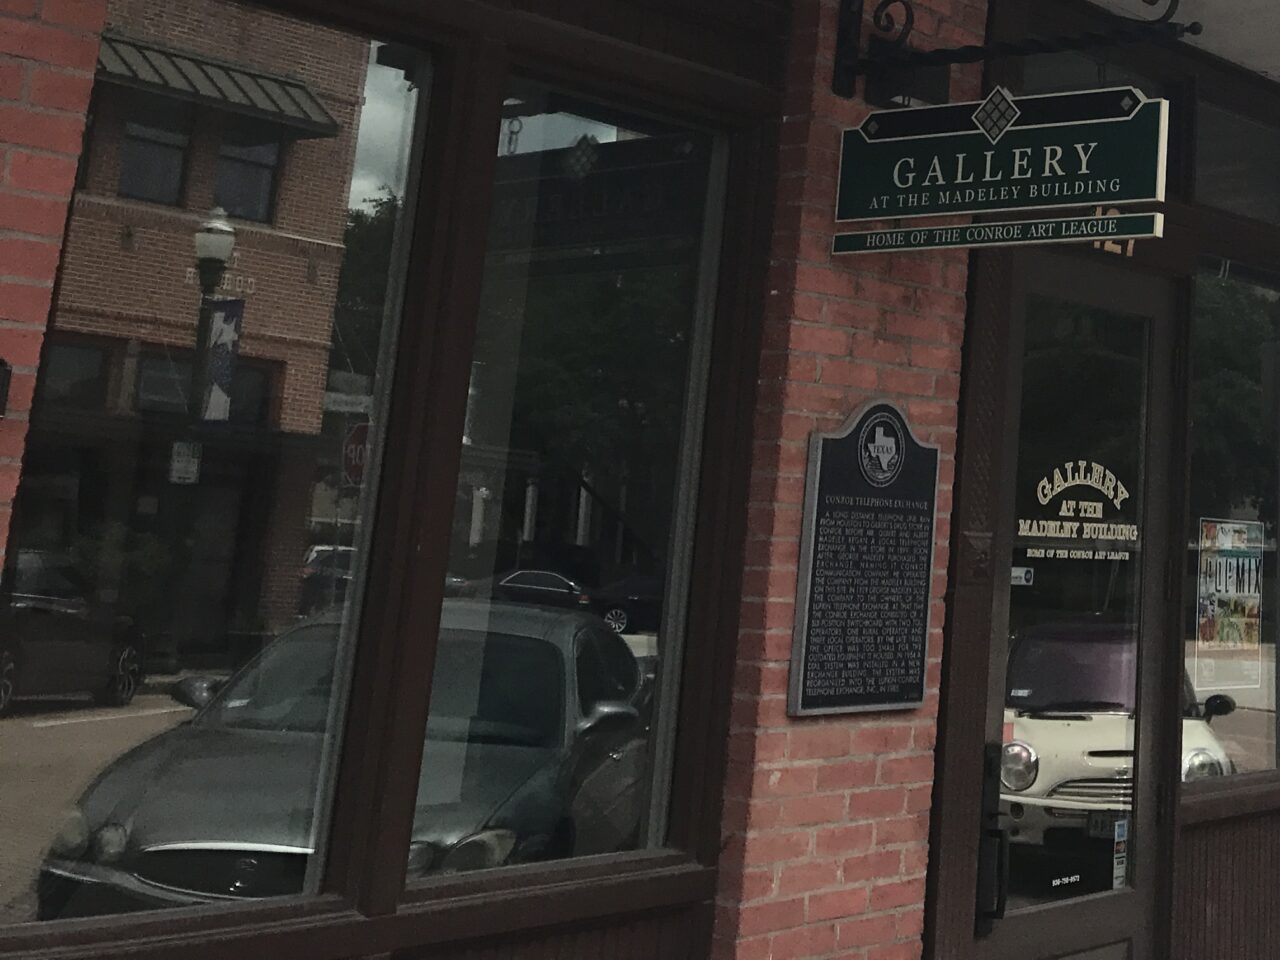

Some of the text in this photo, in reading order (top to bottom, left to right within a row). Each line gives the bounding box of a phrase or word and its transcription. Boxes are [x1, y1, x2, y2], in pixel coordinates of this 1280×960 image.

[893, 142, 1098, 188] GALLERY
[868, 178, 1121, 210] AT THE MADELEY BUILDING
[866, 219, 1118, 247] HOME OF THE CONROE ART LEAGUE
[872, 444, 893, 454] TEXAS
[1037, 460, 1130, 510] GALLERY
[825, 496, 928, 511] CONROE TELEPHONE EXCHANGE
[1059, 500, 1103, 518] AT THE
[1018, 519, 1138, 540] MADELEY BUILDING
[1026, 548, 1130, 560] HOME OF THE CONROE ART LEAGUE
